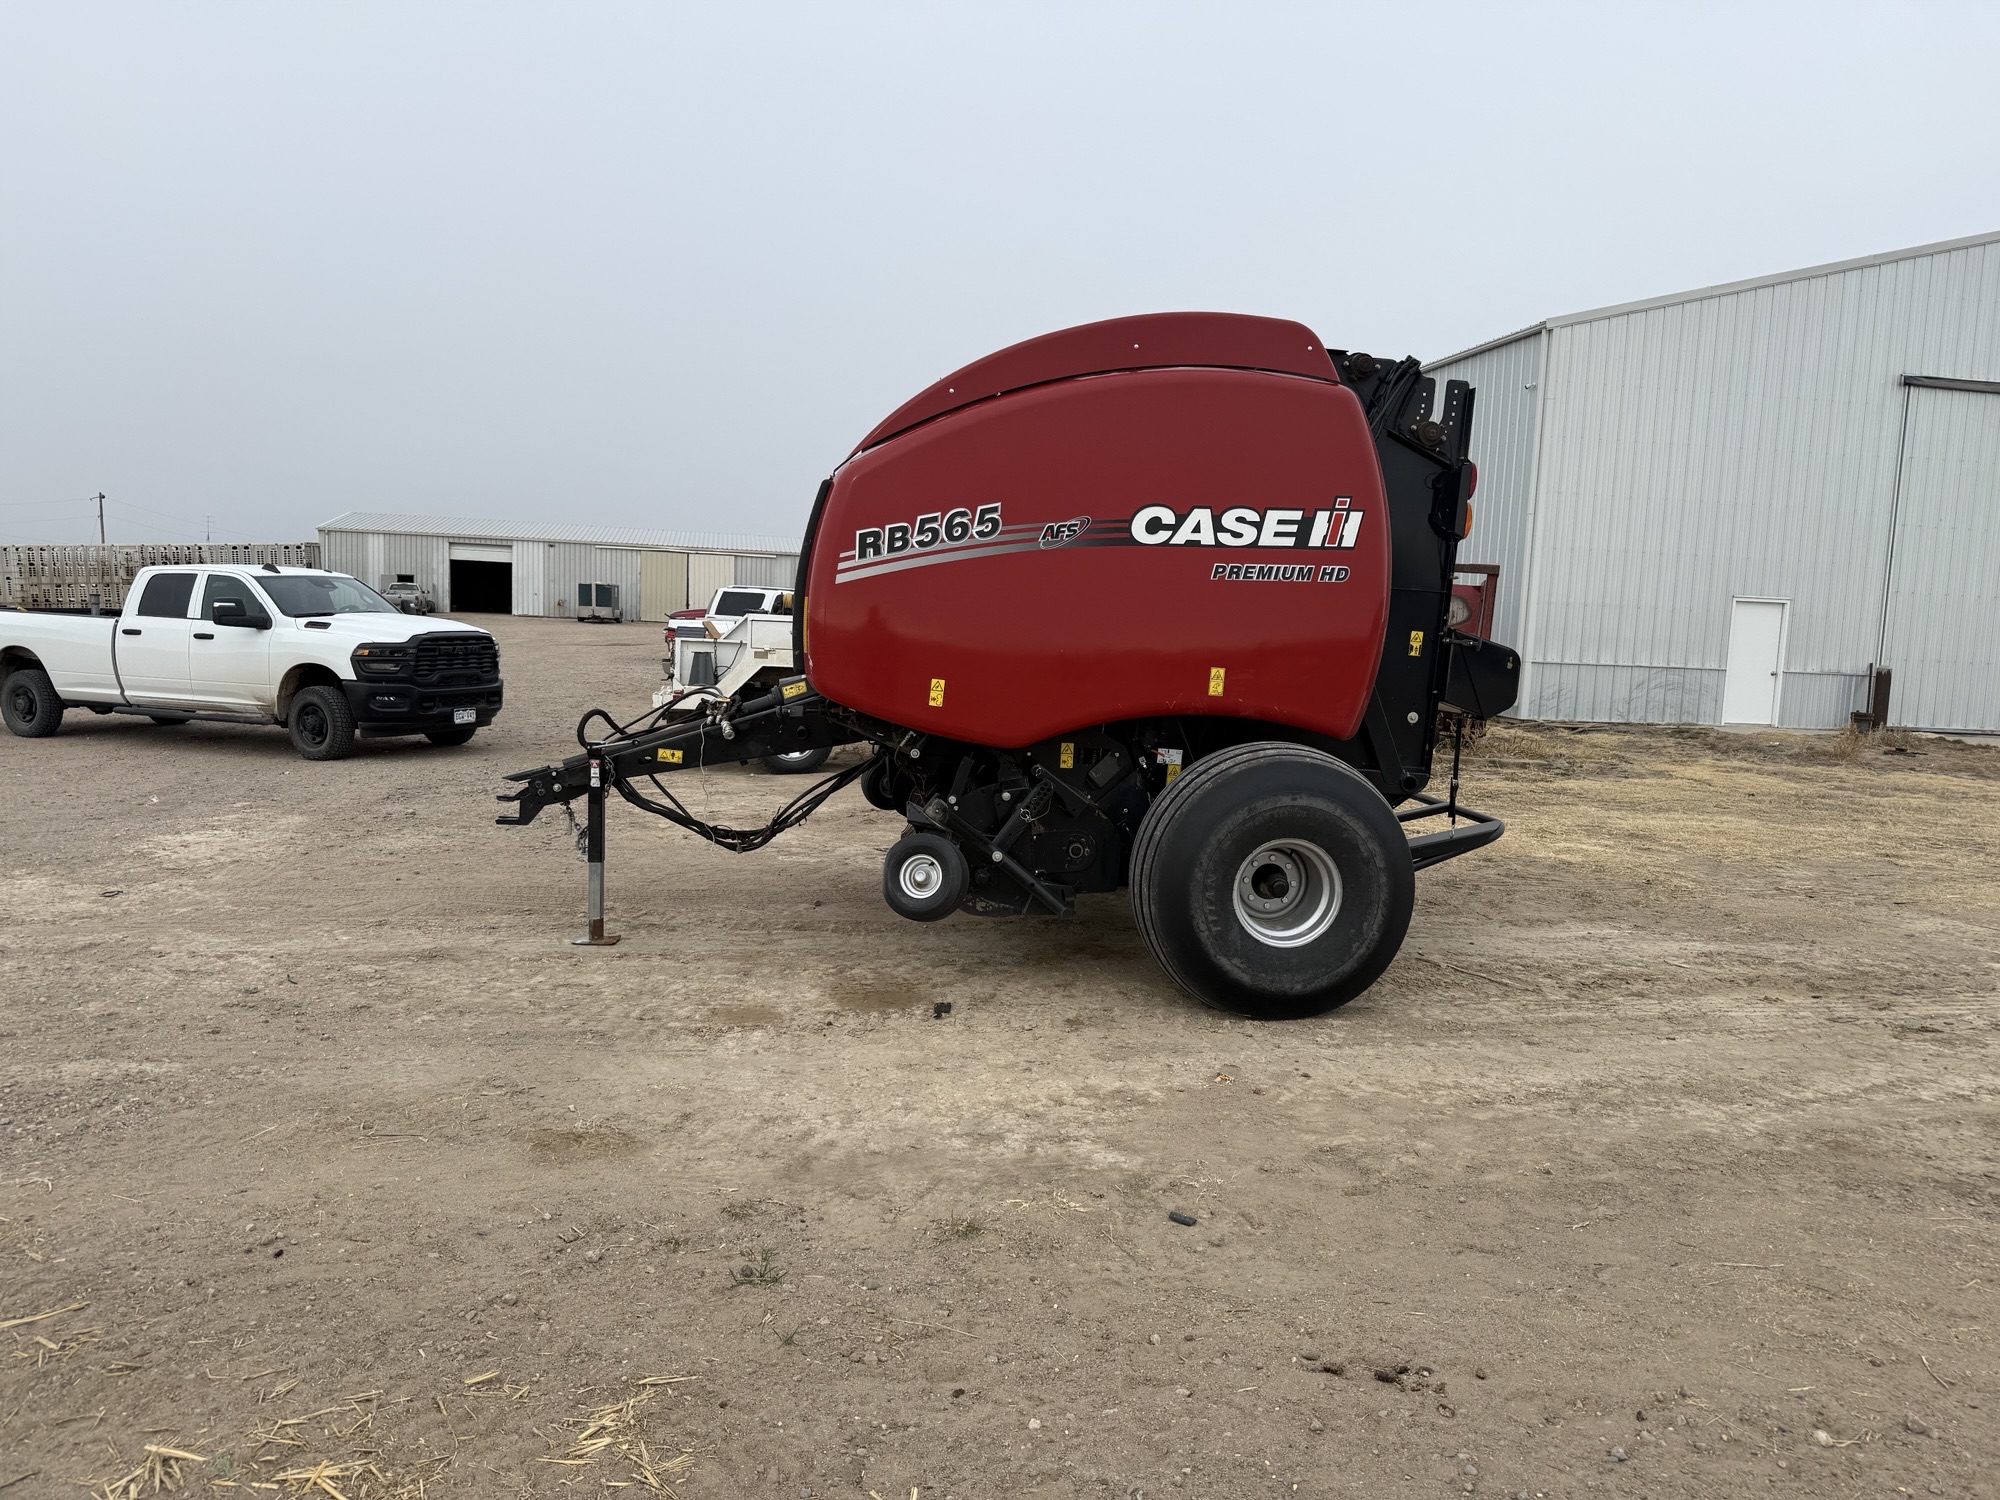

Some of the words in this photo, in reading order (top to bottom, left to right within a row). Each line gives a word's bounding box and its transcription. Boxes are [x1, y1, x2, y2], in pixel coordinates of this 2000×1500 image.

[855, 502, 1002, 562] RB565
[1038, 522, 1082, 543] AFS
[1131, 505, 1304, 547] CASE
[1210, 563, 1315, 582] PREMIUM
[1317, 565, 1350, 582] HD
[439, 646, 482, 656] RAM
